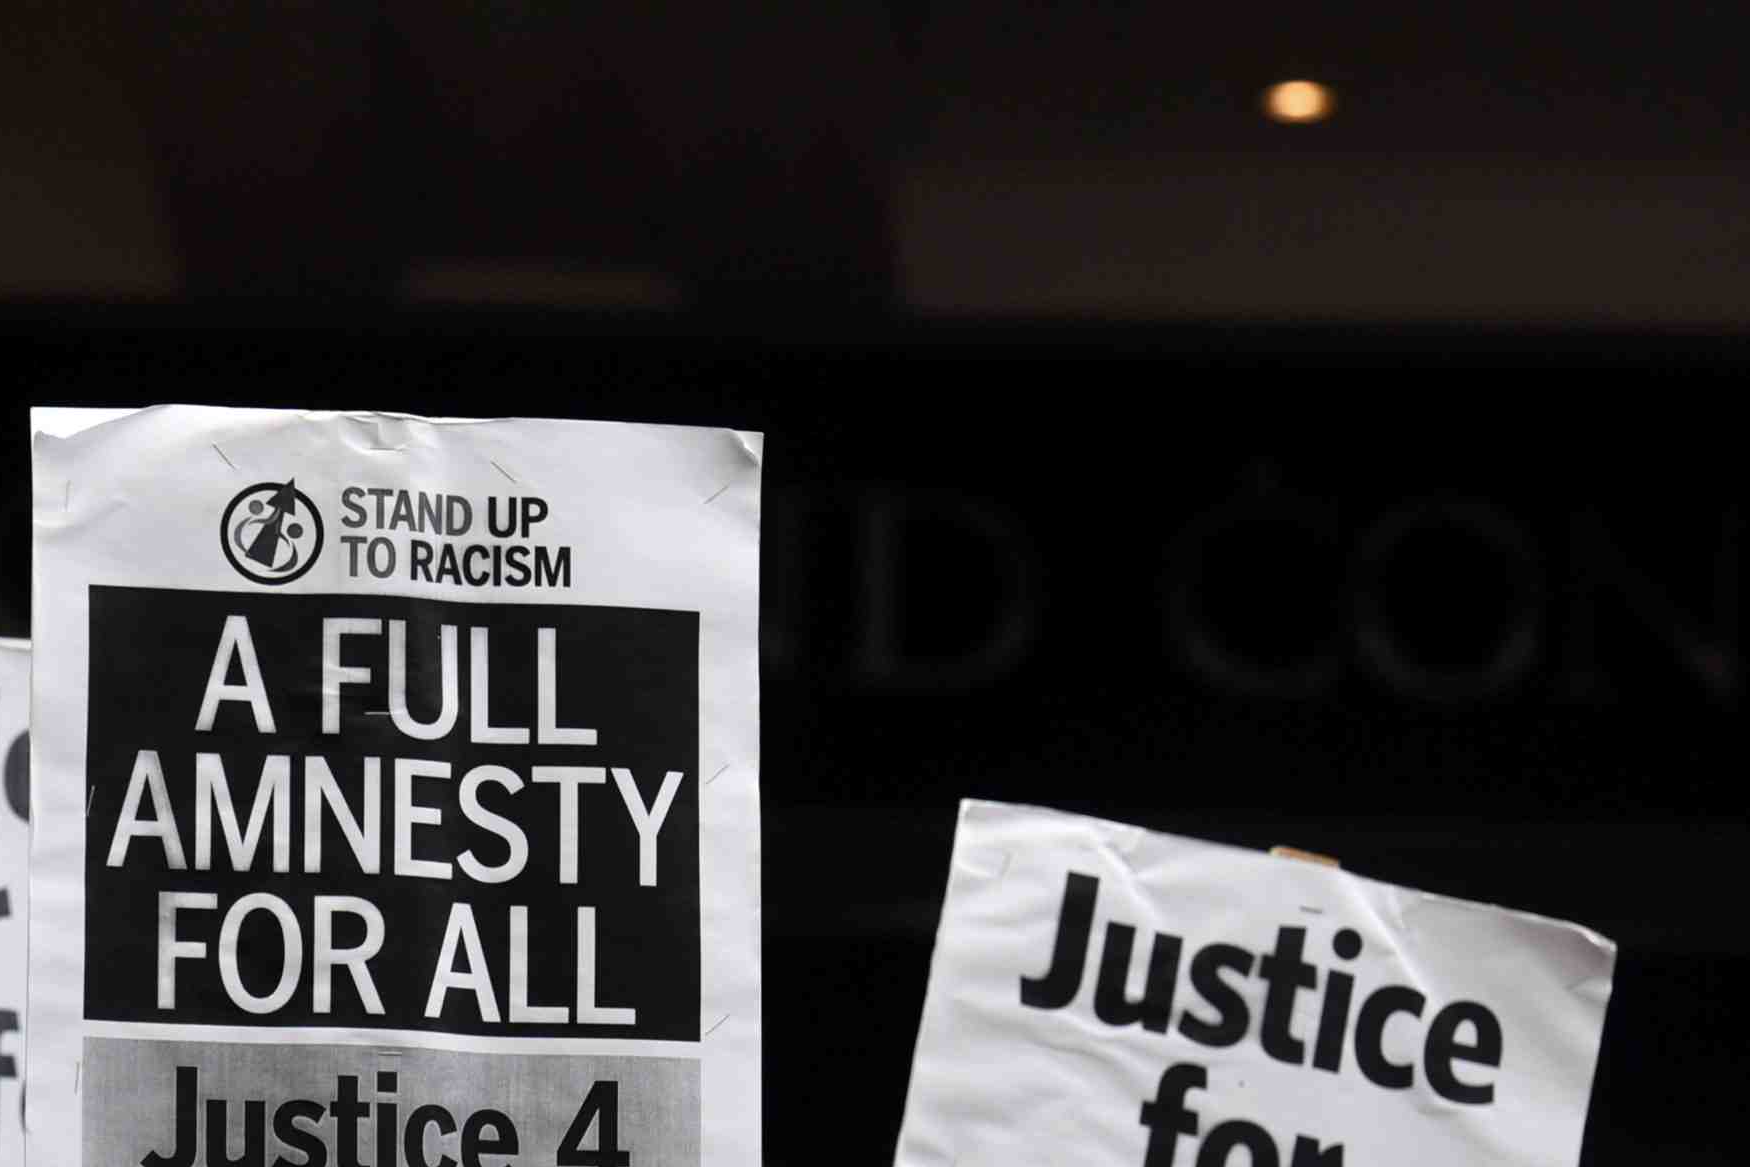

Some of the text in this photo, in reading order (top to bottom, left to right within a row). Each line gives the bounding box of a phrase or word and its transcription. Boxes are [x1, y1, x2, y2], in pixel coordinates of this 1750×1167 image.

[340, 486, 548, 538] STAND UP
[341, 536, 571, 588] TO RACISM
[194, 616, 598, 746] A FULL
[105, 750, 684, 886] AMNESTY
[157, 891, 636, 1024] FOR ALL
[1021, 871, 1503, 1105] Justice
